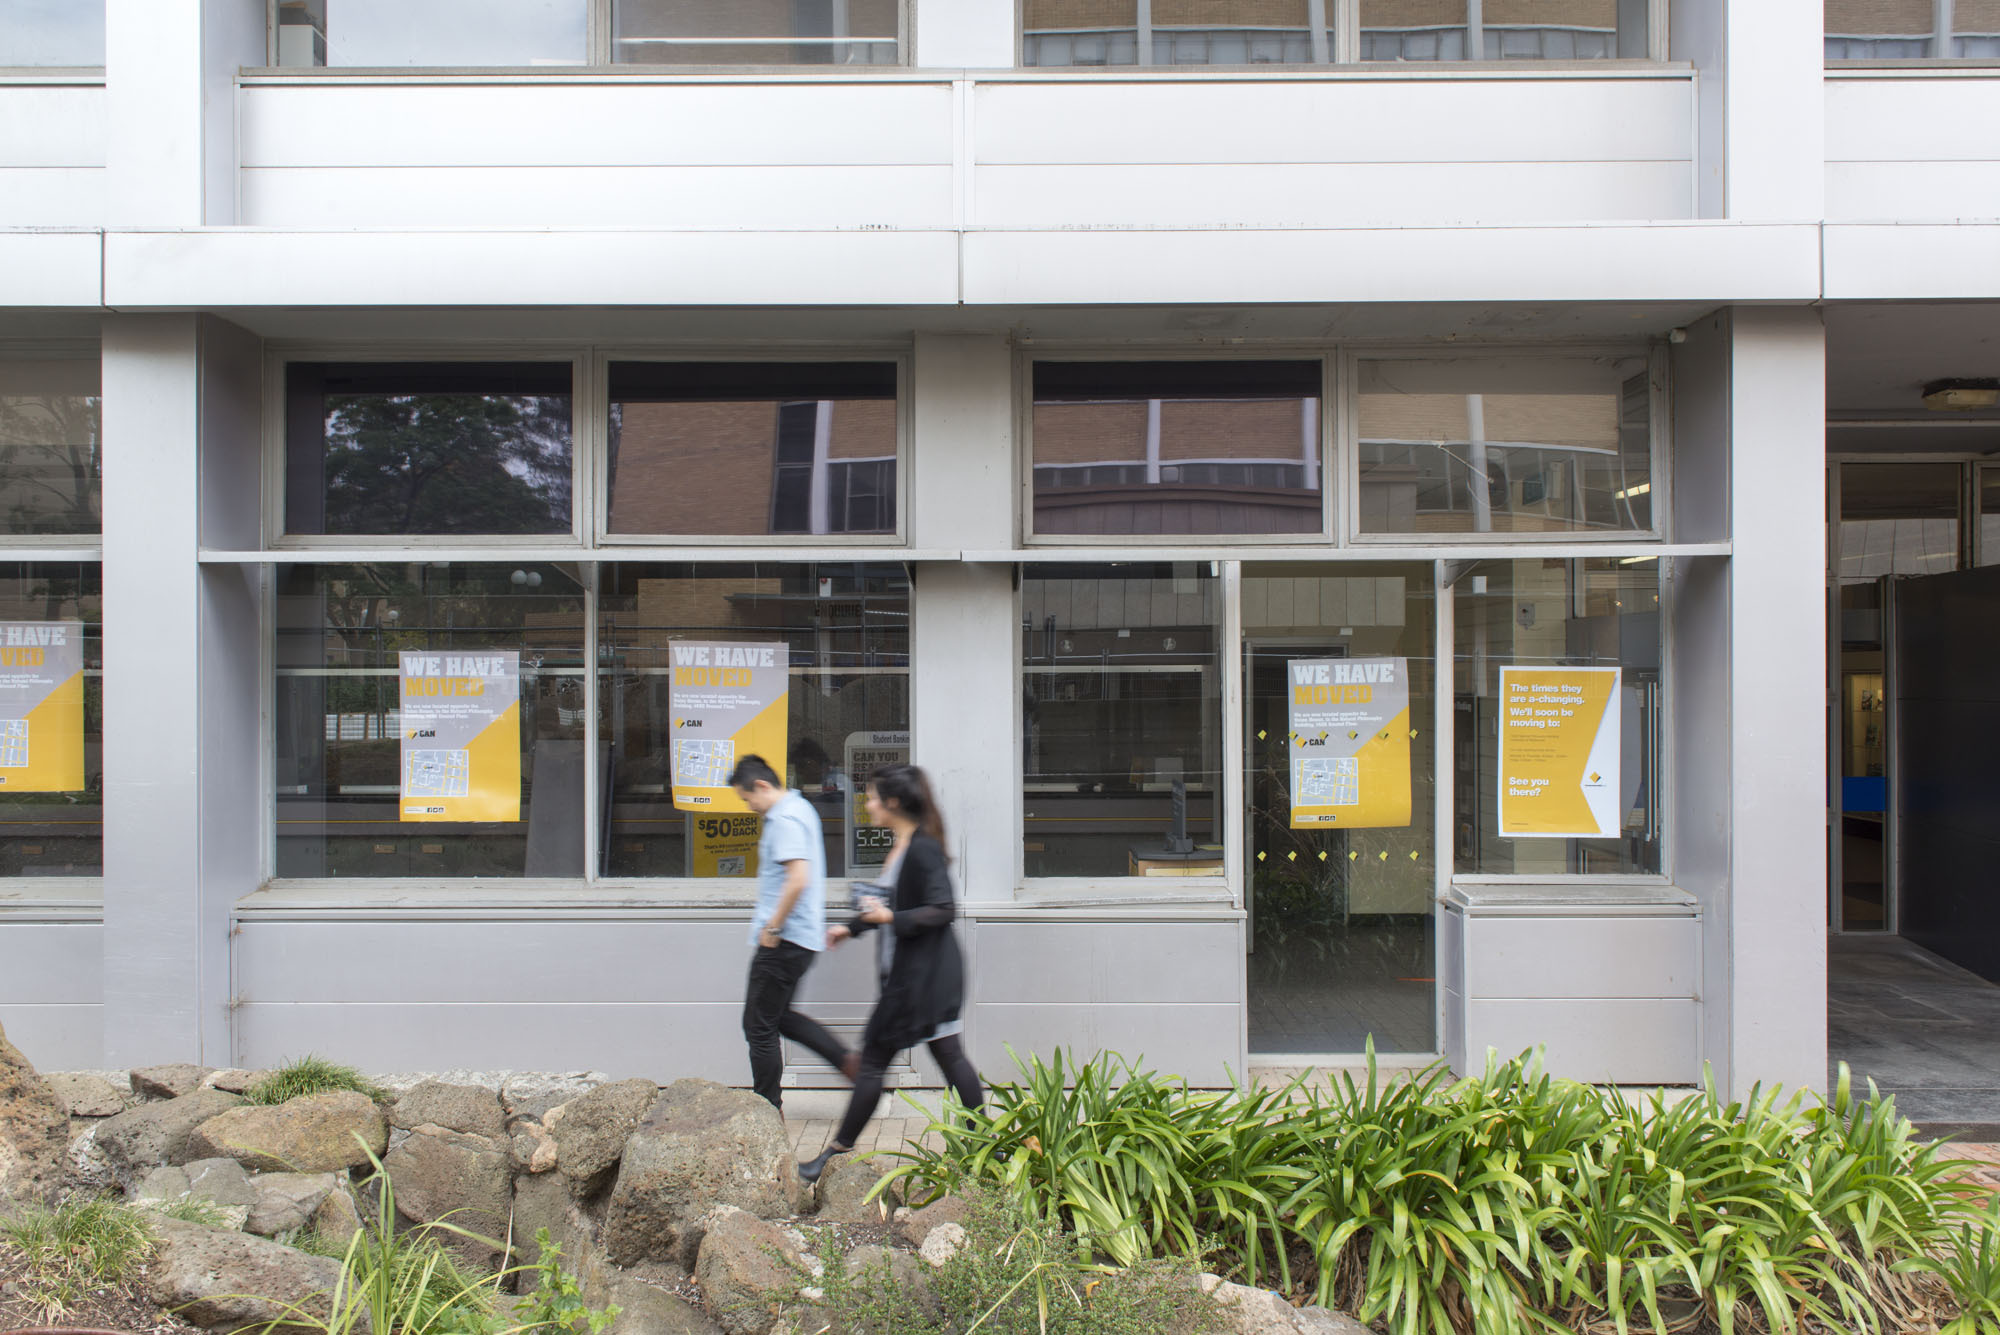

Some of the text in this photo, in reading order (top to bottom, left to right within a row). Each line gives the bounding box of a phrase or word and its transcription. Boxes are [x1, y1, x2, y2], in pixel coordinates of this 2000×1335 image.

[7, 627, 66, 646] HAVE
[0, 648, 44, 666] VED
[674, 647, 774, 667] WE HAVE
[404, 657, 504, 676] WE HAVE
[674, 668, 752, 687] MOVED
[1294, 664, 1394, 684] WE HAVE
[405, 677, 484, 696] MOVED
[1510, 684, 1583, 694] The times they
[1294, 685, 1372, 704] MOVED
[1528, 695, 1585, 705] a-changing.
[1510, 707, 1532, 716] We'll
[1562, 708, 1574, 716] be
[686, 720, 702, 728] CAN
[1510, 719, 1560, 728] moving to:
[873, 734, 910, 744] Student Bankin
[854, 752, 898, 762] CAN YOU
[1509, 776, 1549, 787] See you
[1510, 788, 1541, 796] there?
[732, 817, 757, 826] CASH
[698, 818, 732, 838] $50
[732, 826, 758, 836] BACK
